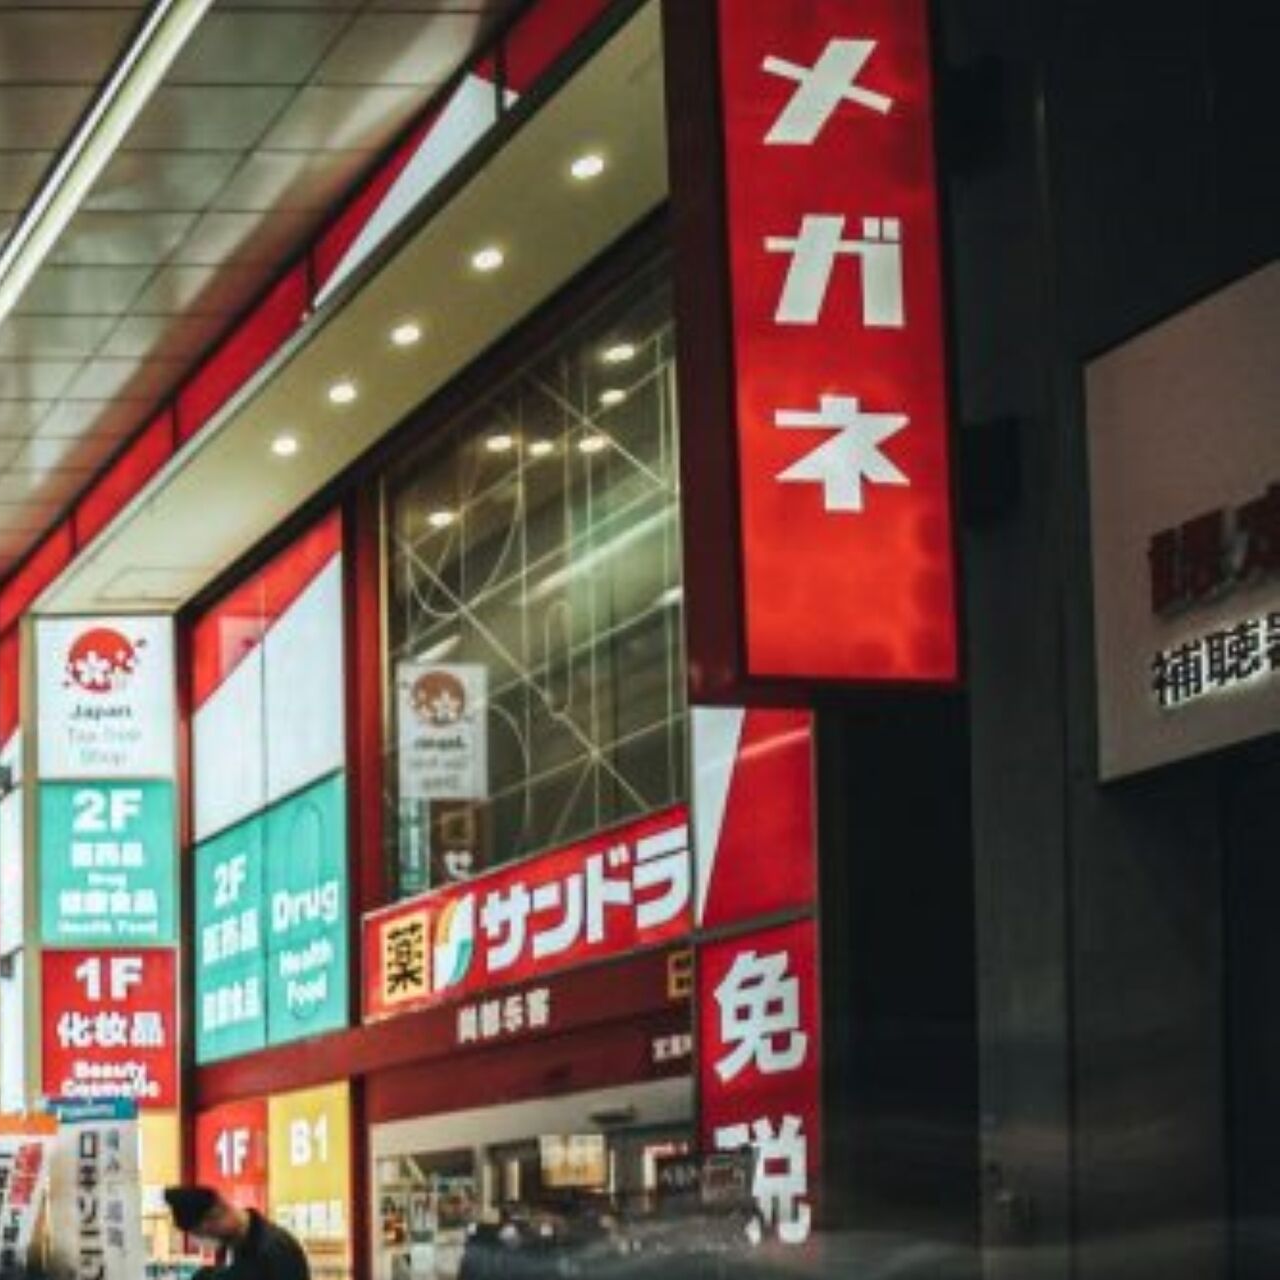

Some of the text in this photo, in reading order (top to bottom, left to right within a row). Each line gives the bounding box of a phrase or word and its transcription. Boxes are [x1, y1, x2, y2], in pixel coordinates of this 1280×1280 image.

[762, 38, 910, 512] メガネ
[69, 703, 133, 721] Japan
[71, 788, 143, 834] 2F
[213, 854, 247, 911] 2F
[272, 880, 339, 934] Drug
[387, 922, 424, 996] 薬
[480, 824, 690, 973] サンドラ
[75, 957, 143, 1001] 1F
[287, 972, 328, 1009] Food
[713, 950, 811, 1246] 免税
[215, 1128, 251, 1175] 1F
[289, 1113, 329, 1167] B1
